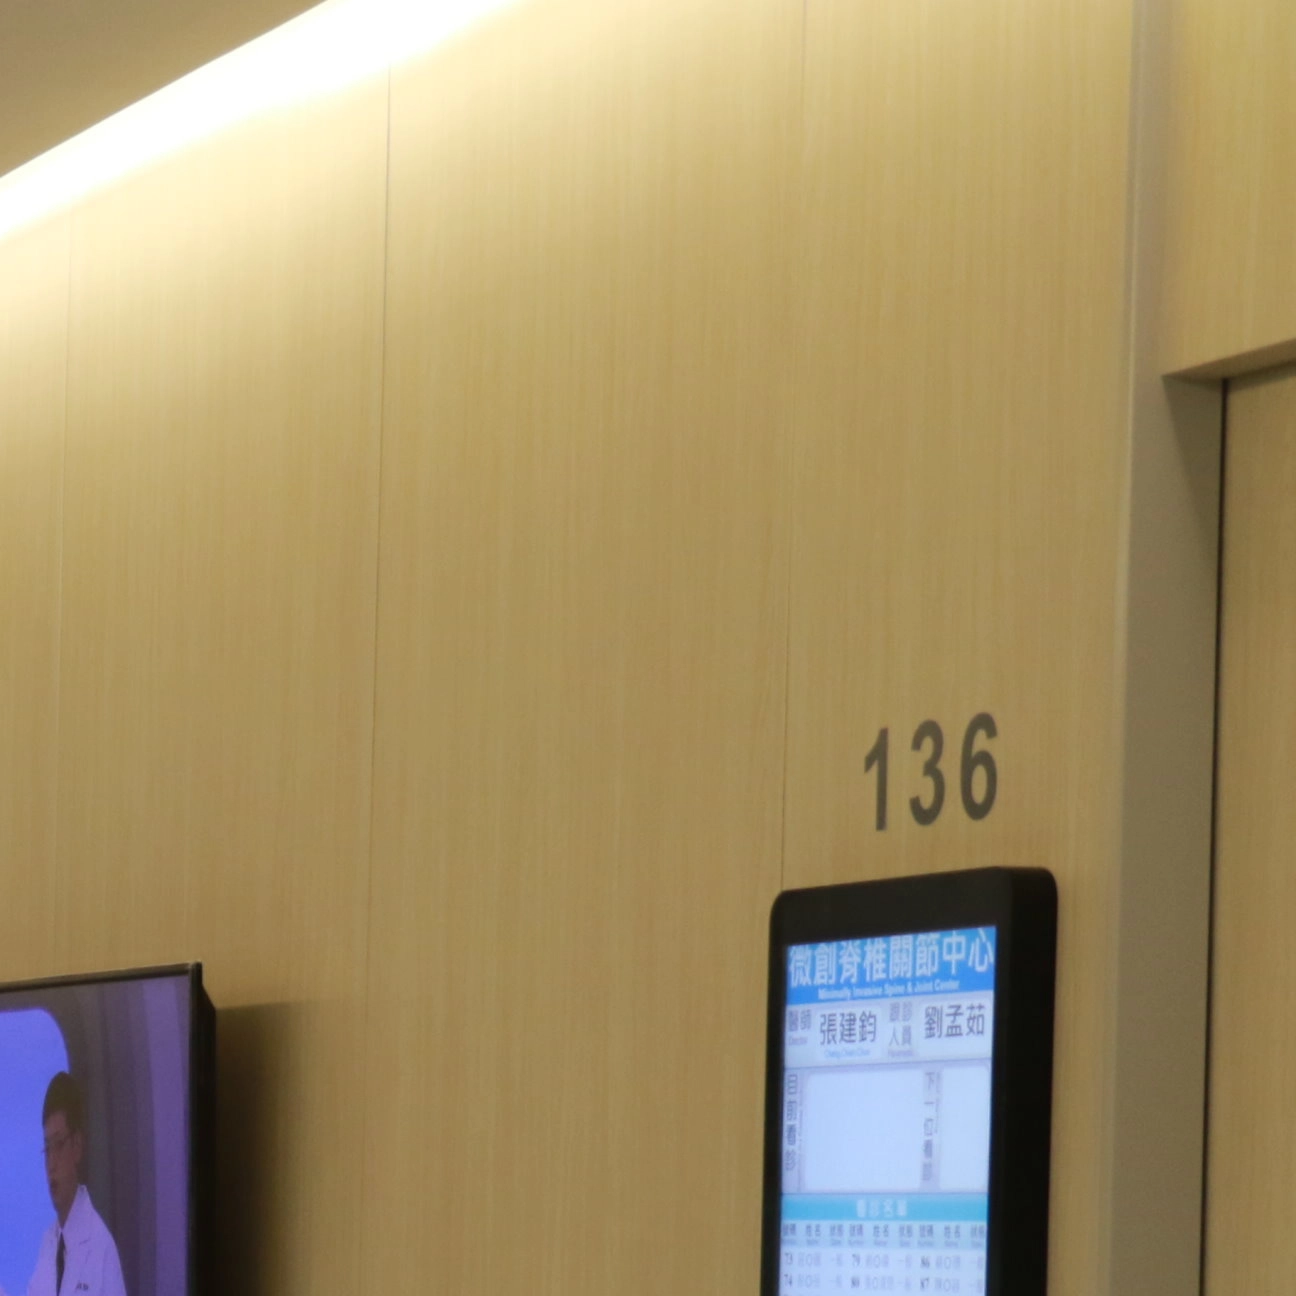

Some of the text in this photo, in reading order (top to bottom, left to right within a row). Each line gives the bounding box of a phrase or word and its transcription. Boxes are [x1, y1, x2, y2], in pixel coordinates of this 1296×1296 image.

[863, 711, 999, 831] 136
[789, 928, 995, 988] 微創脊椎關節中心
[819, 1011, 878, 1046] 張建鈞
[924, 1003, 986, 1040] 劉孟茹
